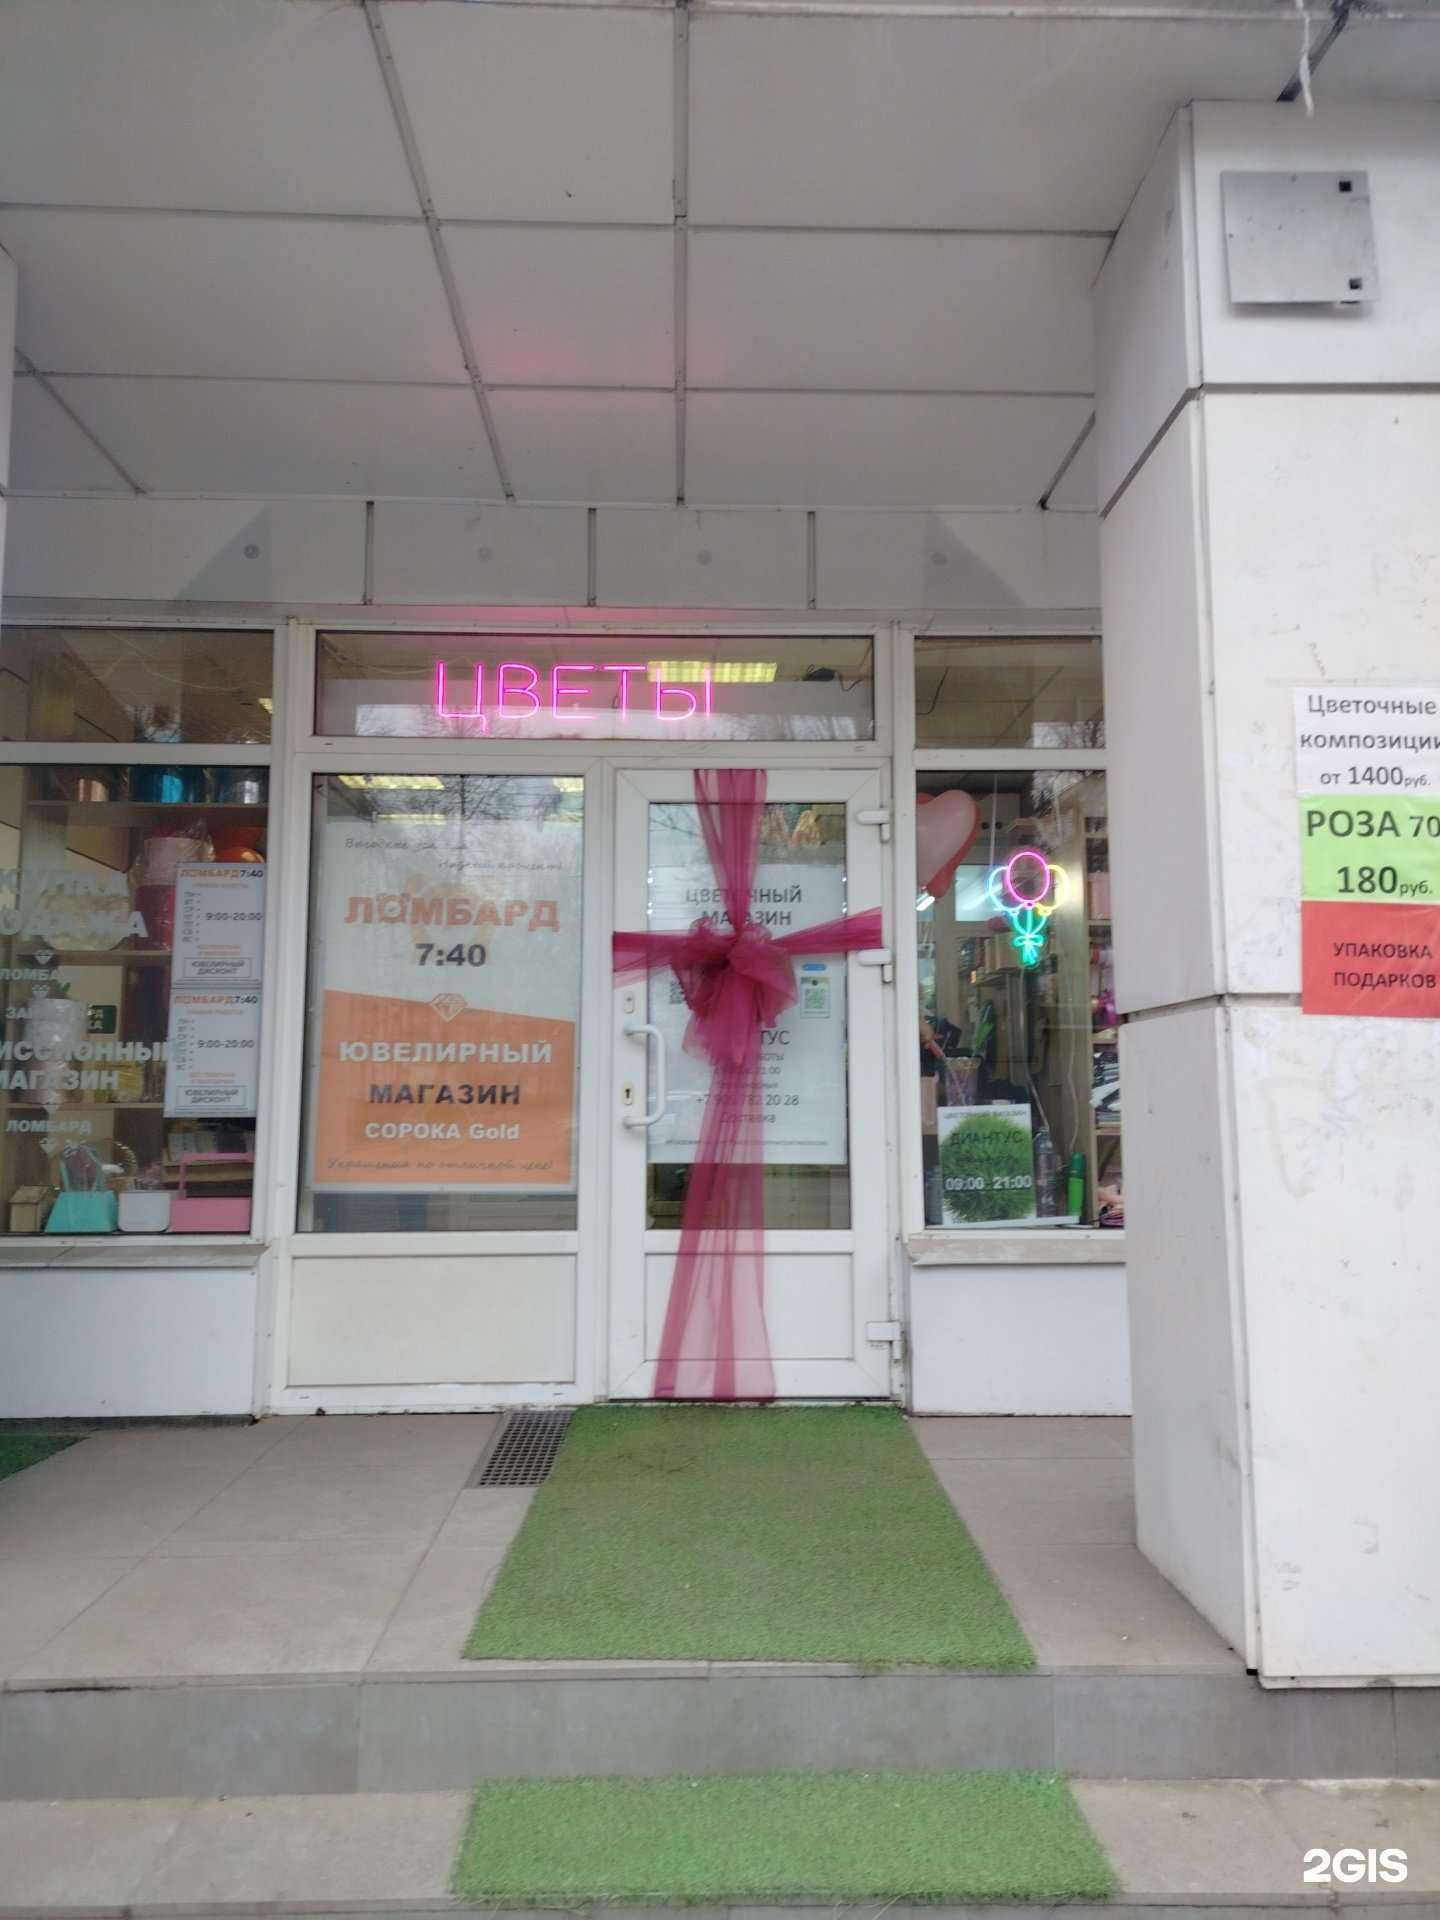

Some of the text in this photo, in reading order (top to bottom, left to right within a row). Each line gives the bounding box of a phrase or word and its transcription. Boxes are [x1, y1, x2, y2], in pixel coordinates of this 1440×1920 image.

[435, 662, 713, 734] ЦВЕТЫ
[1307, 694, 1437, 716] Цветочные
[1320, 772, 1340, 785] от
[1306, 811, 1400, 838] РОЗА
[205, 911, 263, 922] 9:00-20:00
[343, 893, 561, 932] ЛОМБАРД
[701, 910, 792, 927] МААЗИН
[416, 943, 487, 967] 7:40
[1333, 942, 1433, 959] УПАКОВКА
[1333, 971, 1436, 990] ПОДАРКОВ
[198, 1039, 255, 1050] 9:00-20:00
[338, 1040, 553, 1064] ЮВЕЛИРНЫЙ
[369, 1083, 521, 1106] МАГАЗИН
[6, 1119, 92, 1135] ЛОМБАРД
[365, 1122, 521, 1141] СОРОКА Gold
